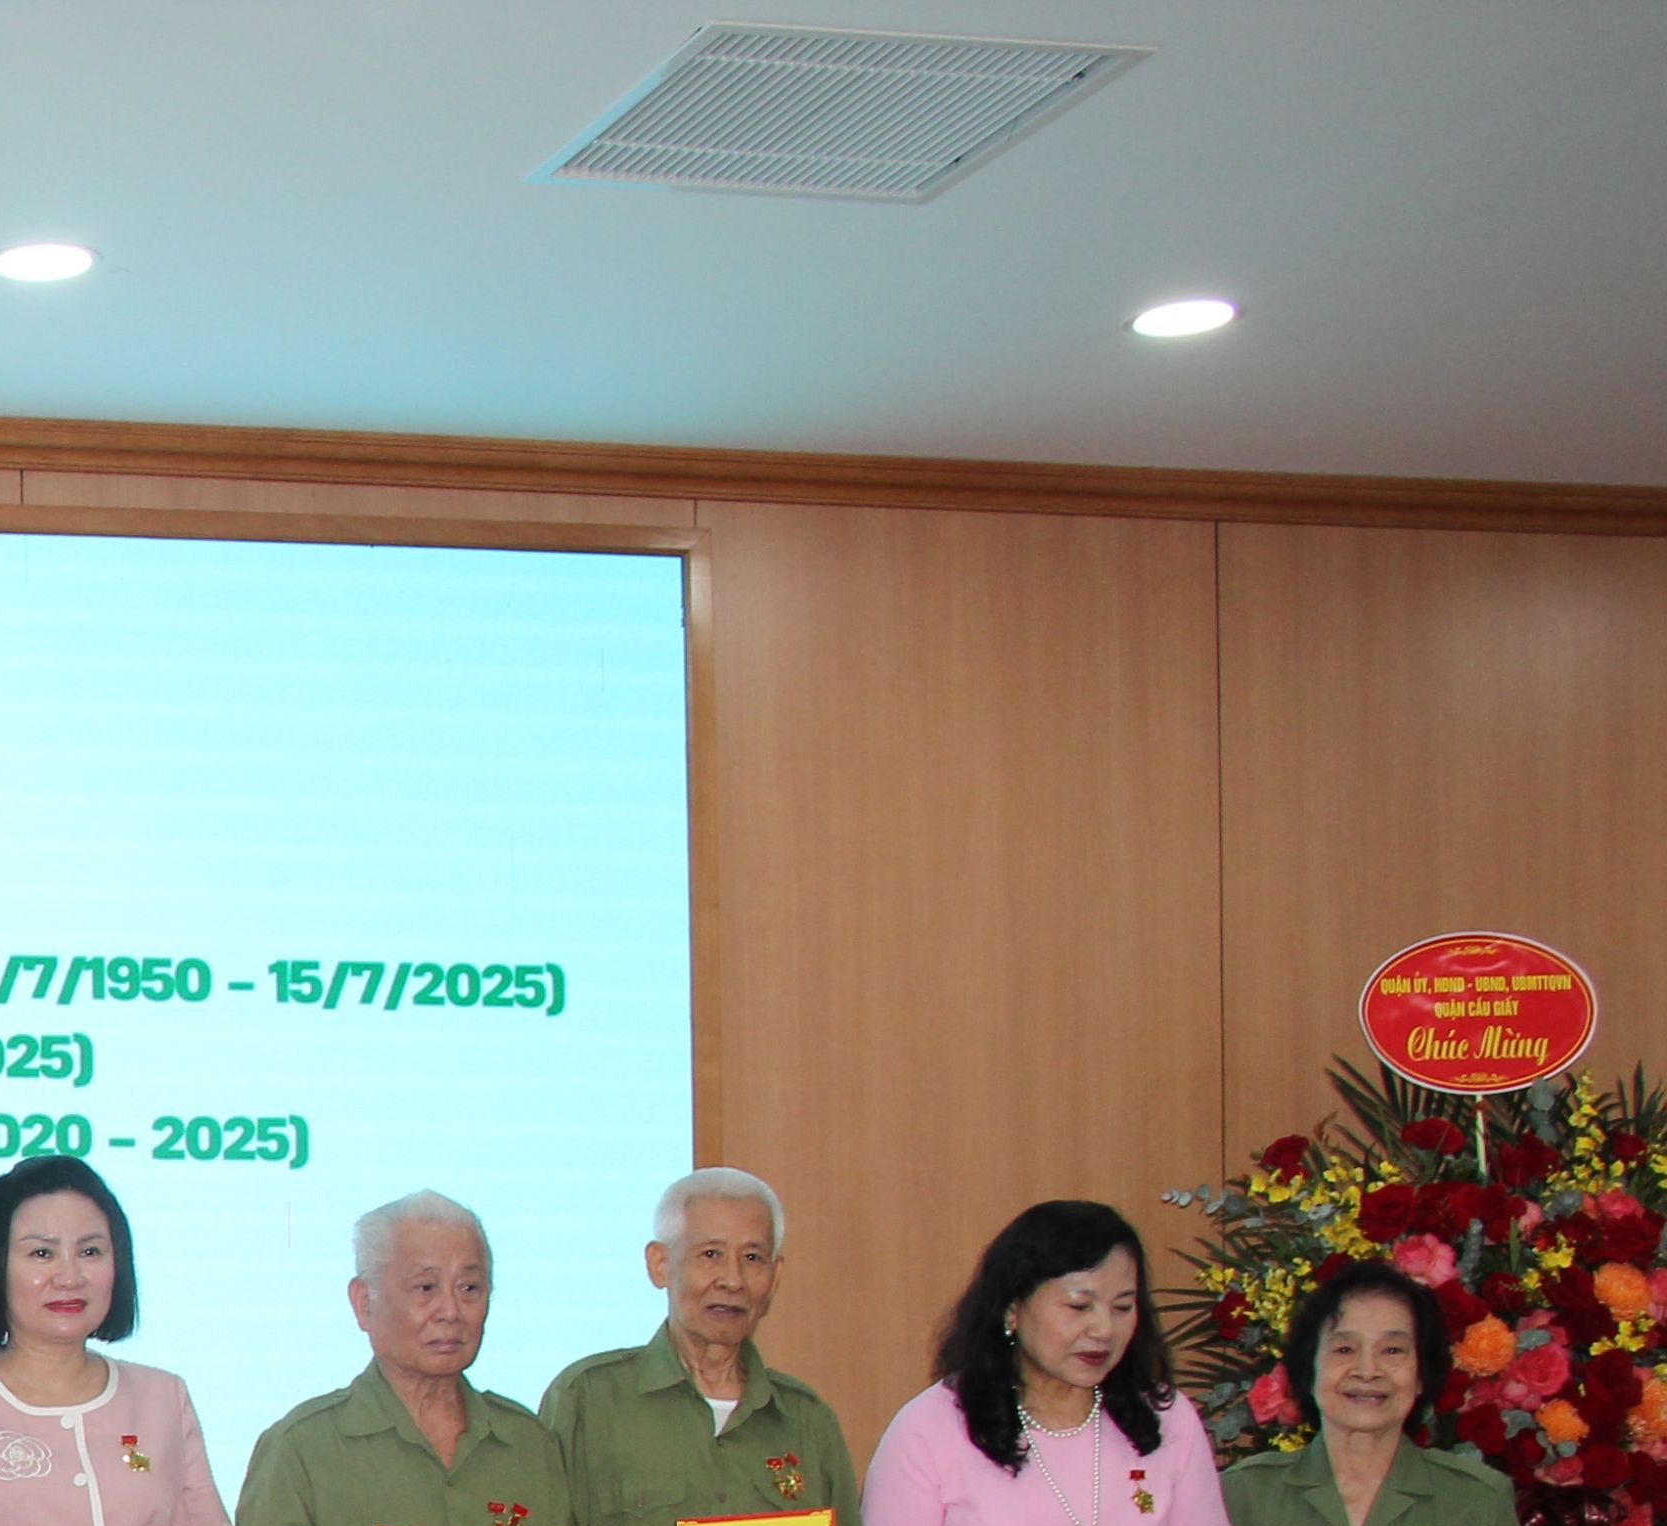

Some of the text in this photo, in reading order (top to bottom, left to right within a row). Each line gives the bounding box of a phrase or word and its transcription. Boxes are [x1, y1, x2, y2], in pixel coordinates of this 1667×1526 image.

[267, 959, 568, 1018] 15/7/2025)
[1381, 975, 1410, 997] QUẬN
[1434, 999, 1465, 1020] QUẬN
[1407, 1025, 1549, 1066] Chúc Mừng
[151, 1113, 311, 1170] 2025)
